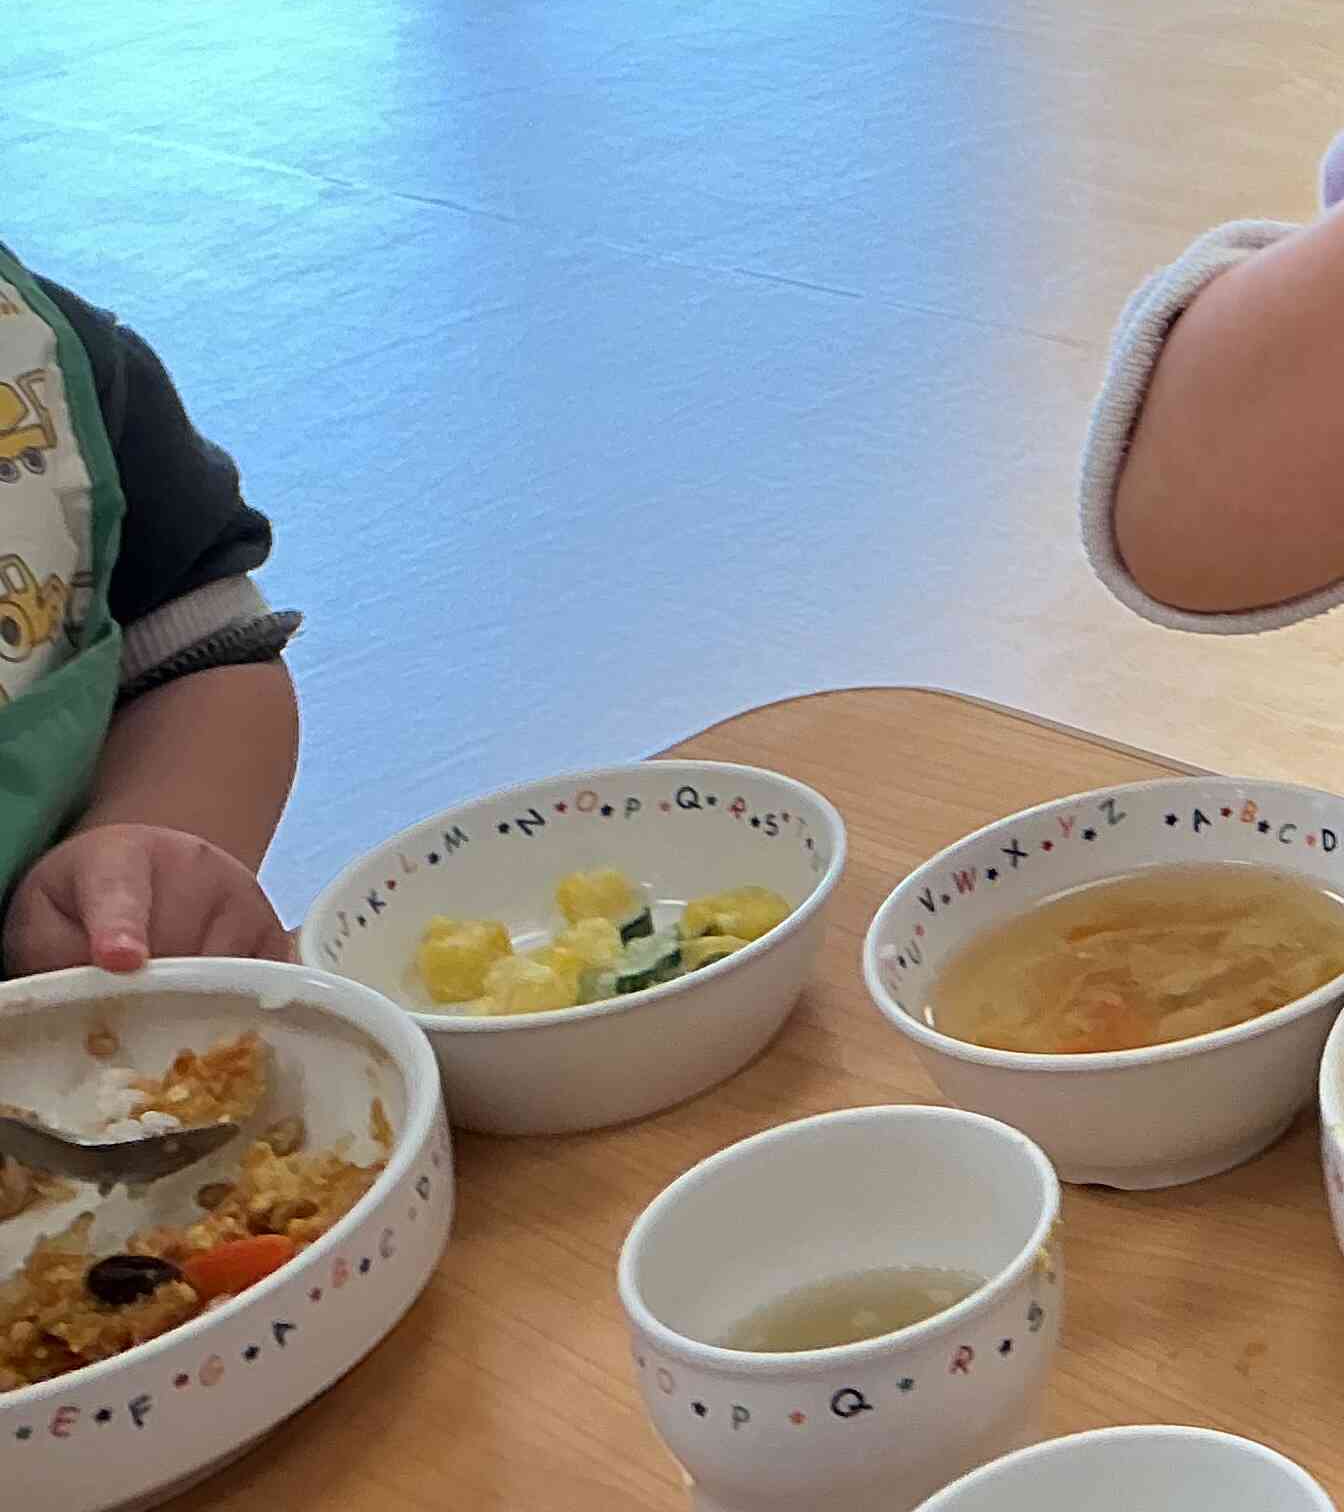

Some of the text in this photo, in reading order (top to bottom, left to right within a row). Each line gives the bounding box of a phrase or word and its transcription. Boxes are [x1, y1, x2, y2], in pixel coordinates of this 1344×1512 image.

[367, 890, 387, 914] K
[442, 826, 469, 853] M
[515, 808, 546, 836] N
[625, 798, 641, 819] P
[676, 786, 702, 810] Q
[729, 797, 746, 819] R
[764, 814, 778, 836] S
[916, 888, 935, 913] V
[953, 868, 976, 894] W
[1000, 839, 1028, 868] X
[1058, 815, 1075, 838] Y
[1098, 798, 1126, 825] Z
[1193, 808, 1212, 833] A
[1240, 800, 1258, 823] B
[1279, 823, 1297, 844] C
[1322, 828, 1337, 852] D
[50, 1406, 80, 1438] E
[129, 1394, 152, 1428] F
[732, 1403, 750, 1430] P
[830, 1388, 873, 1418] Q
[949, 1345, 974, 1375] R
